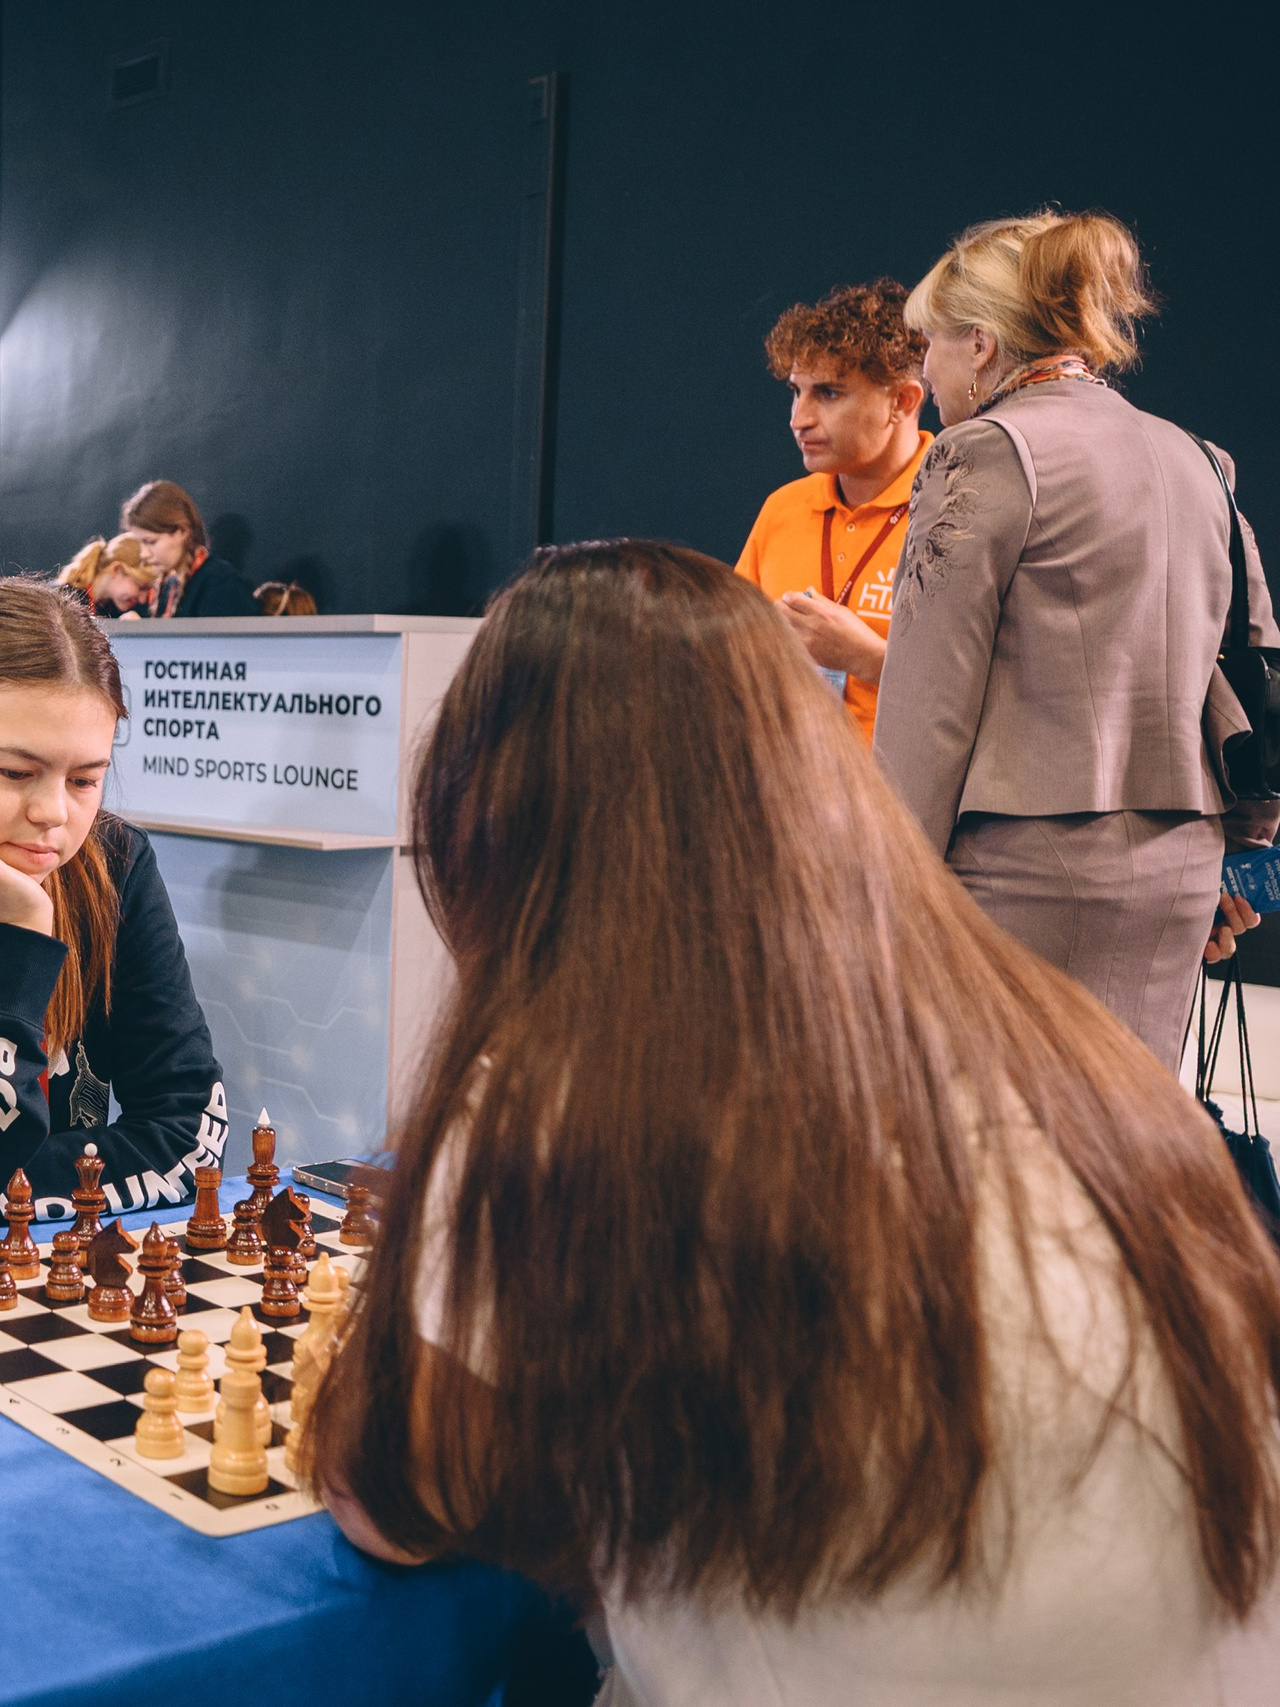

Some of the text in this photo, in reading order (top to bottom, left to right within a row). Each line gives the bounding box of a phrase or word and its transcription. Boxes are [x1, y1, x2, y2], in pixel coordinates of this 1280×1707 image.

[144, 660, 247, 681] ГОСТИНАЯ
[143, 688, 382, 717] ИНТЕЛЛЕКТУАЛЬНОГО
[143, 718, 220, 740] СПОРТА
[143, 754, 359, 791] MIND SPORTS LOUNGE
